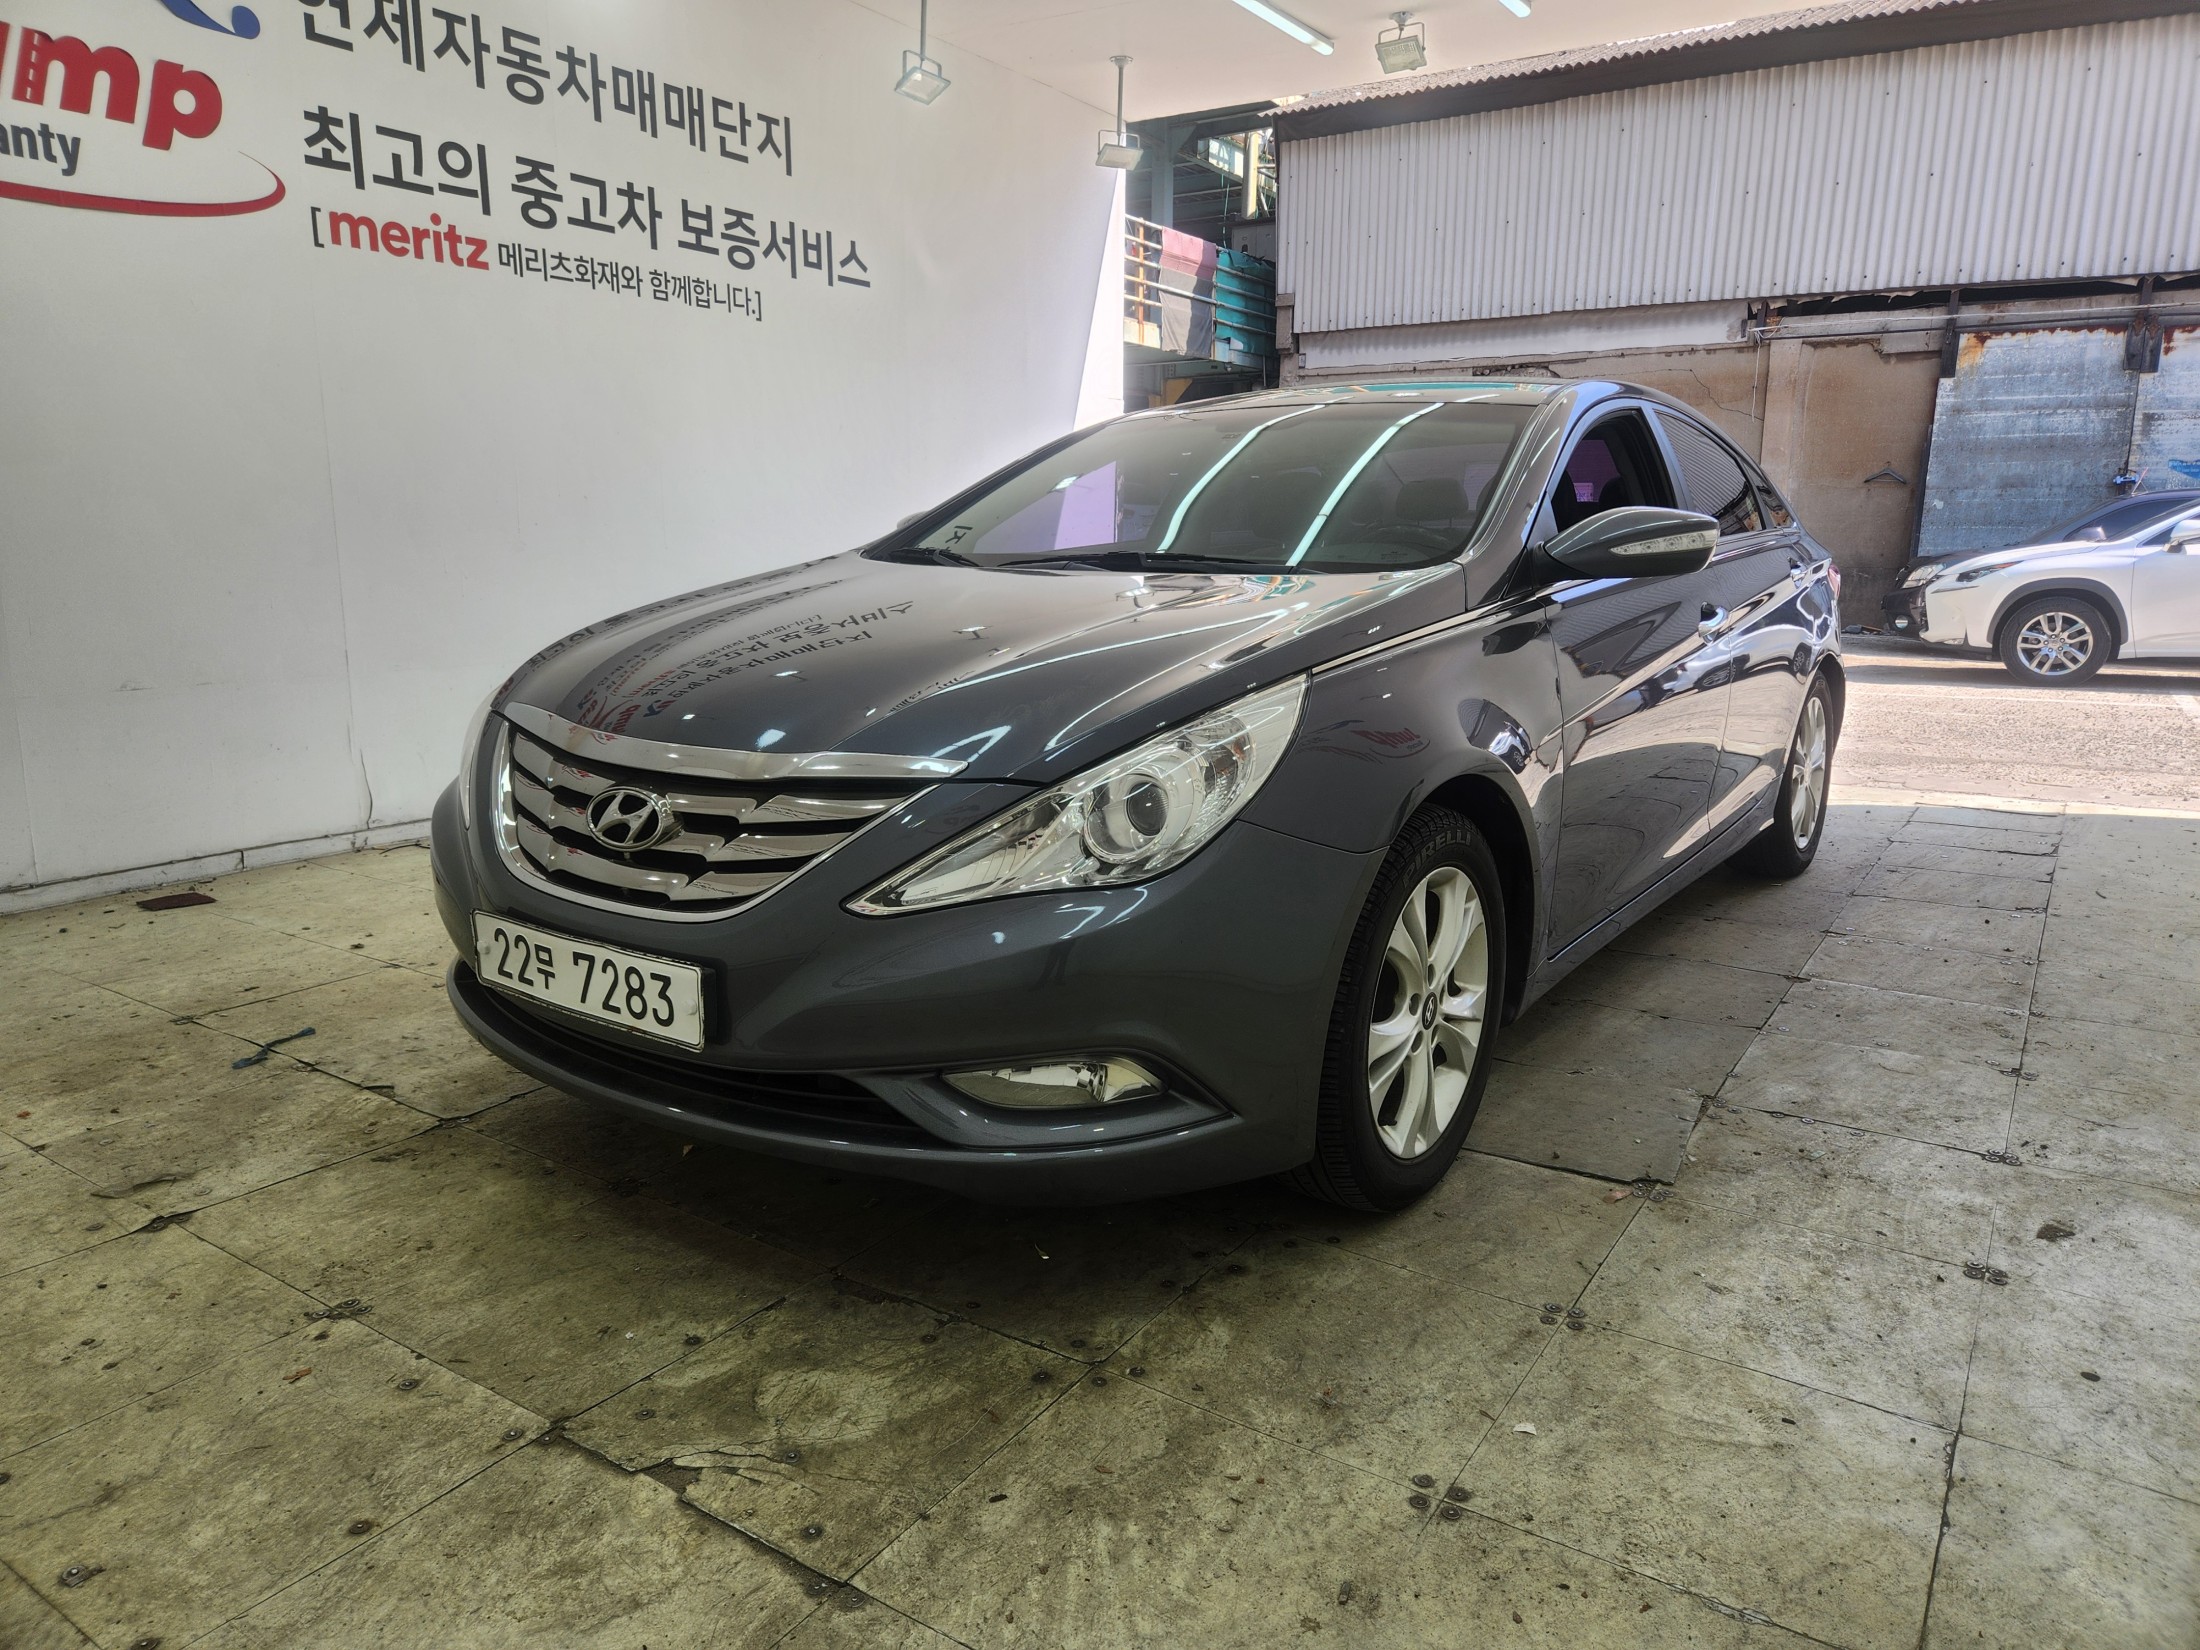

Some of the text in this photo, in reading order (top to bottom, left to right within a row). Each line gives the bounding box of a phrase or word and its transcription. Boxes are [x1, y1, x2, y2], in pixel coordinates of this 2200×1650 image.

[0, 20, 223, 151] mp
[303, 105, 871, 288] 최고의 중고차 보증서비스
[497, 242, 644, 298] 메리츠화재와
[1403, 829, 1471, 888] PIRELLI
[494, 927, 675, 1028] 22무 7283
